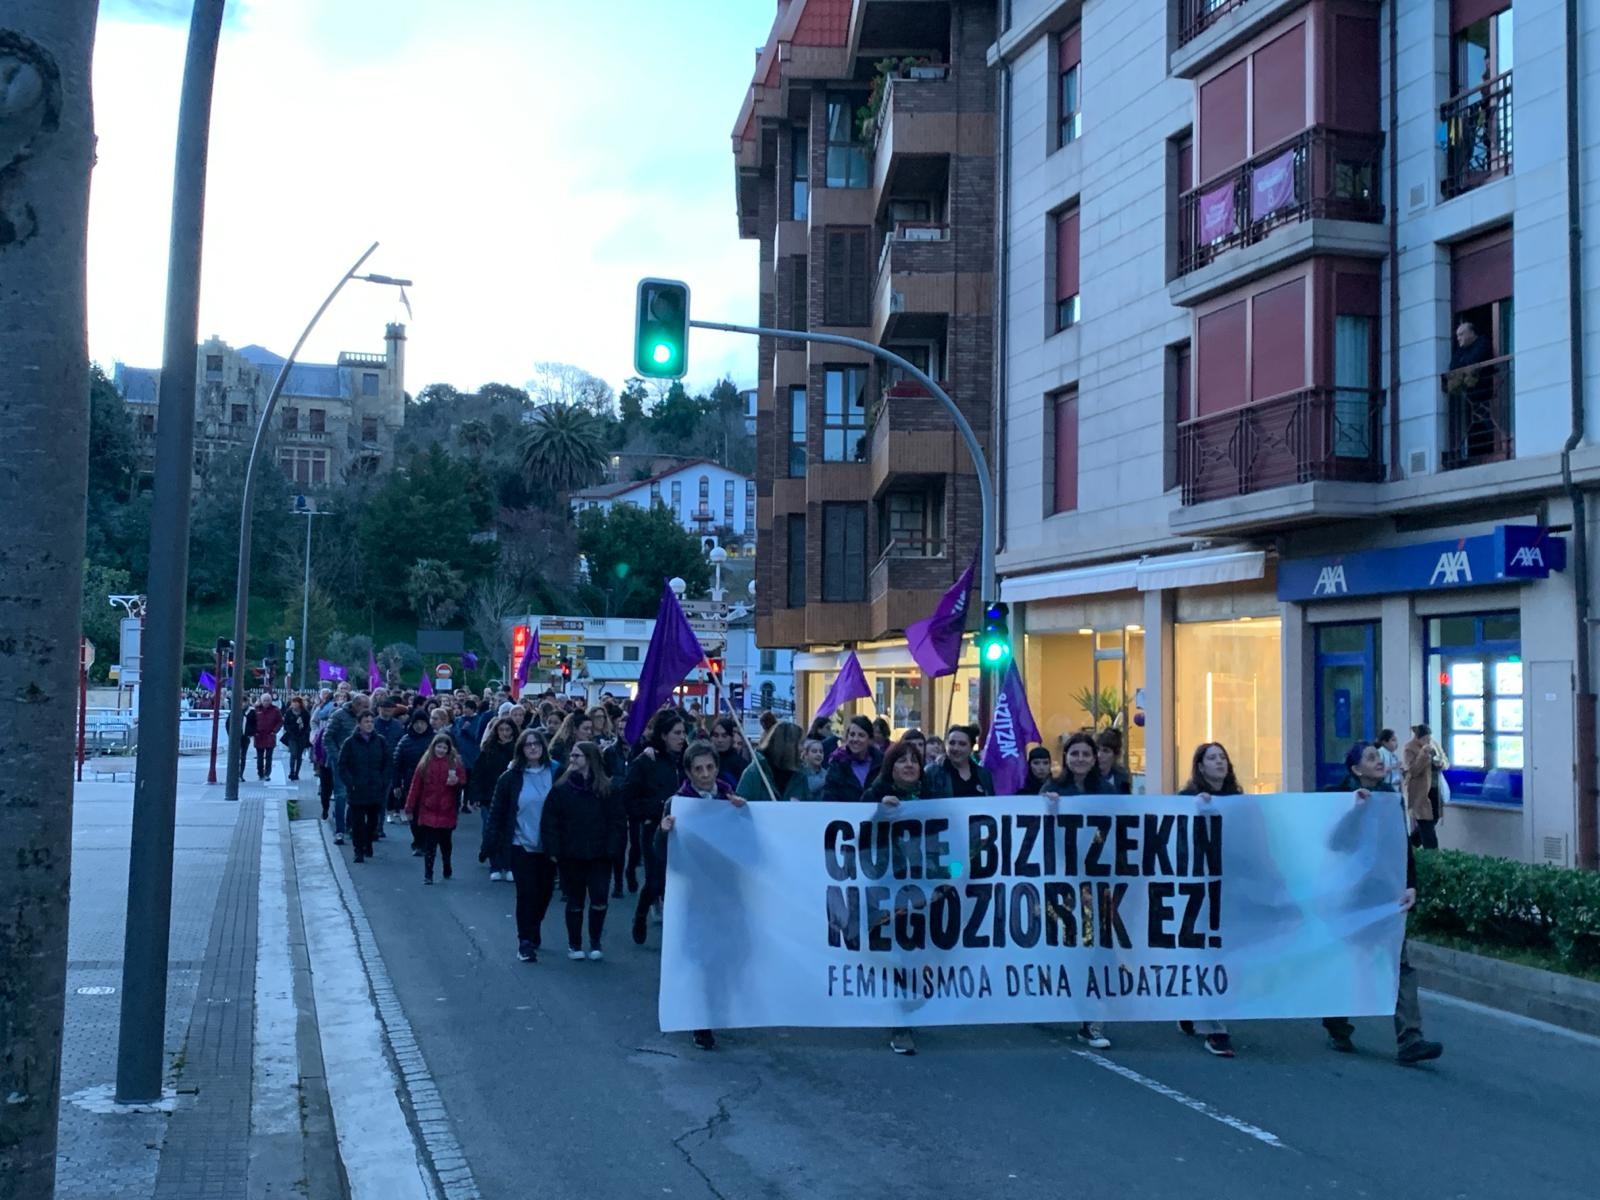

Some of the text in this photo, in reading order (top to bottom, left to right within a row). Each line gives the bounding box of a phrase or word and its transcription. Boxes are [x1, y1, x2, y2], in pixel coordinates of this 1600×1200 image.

[1430, 551, 1472, 585] AXA
[1510, 547, 1544, 567] AXA
[1313, 565, 1347, 594] AXA
[824, 814, 1223, 881] GURE BIZITZEKIN
[826, 880, 1222, 951] NEGOZIORIK EZ!
[827, 963, 1228, 999] FEMINISMOA DENA ALDATZEKO
